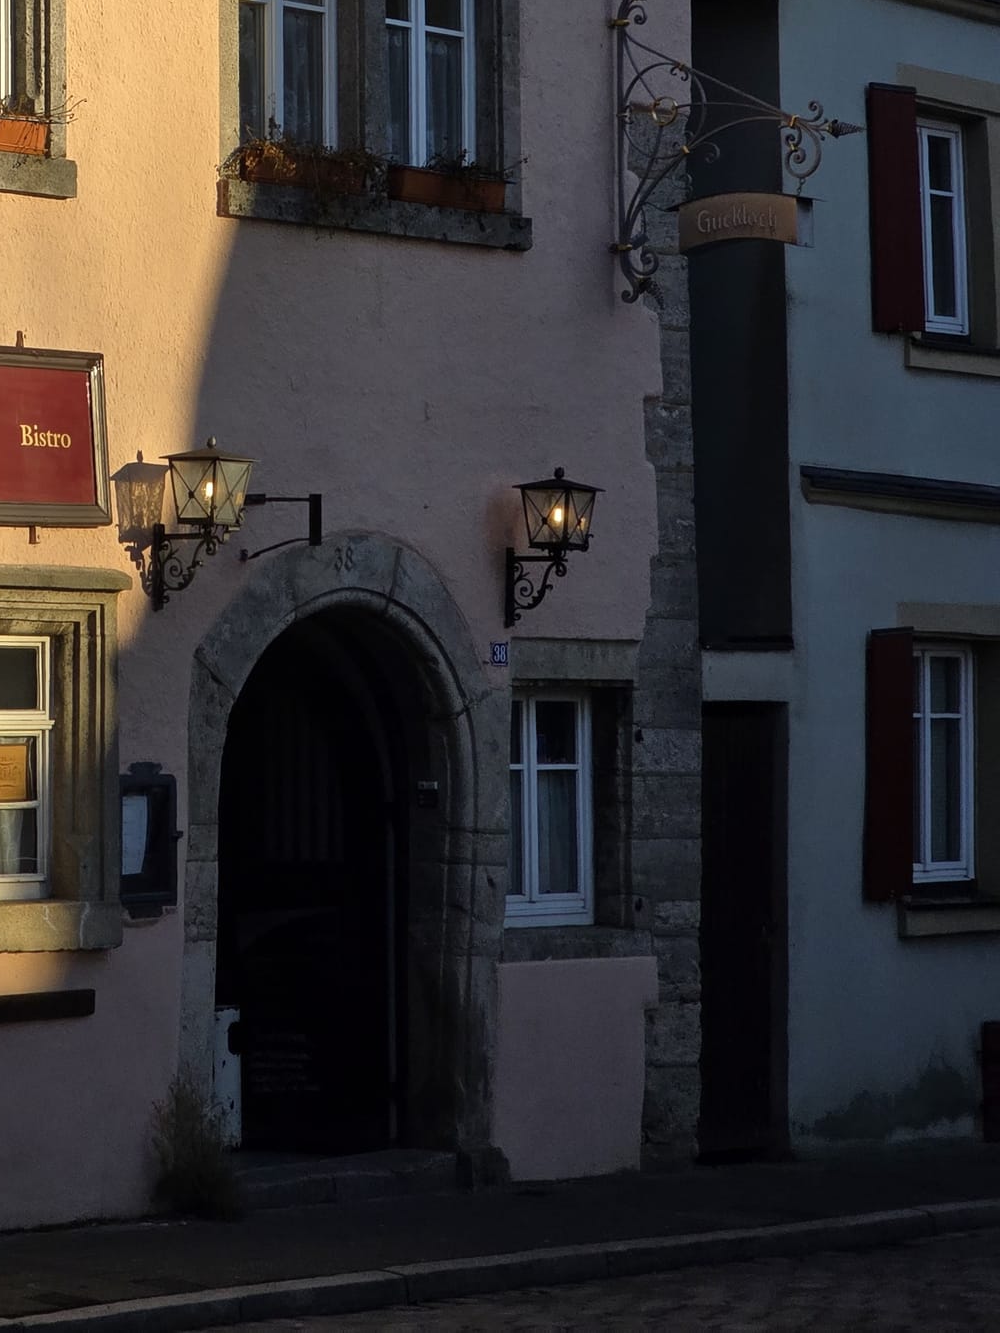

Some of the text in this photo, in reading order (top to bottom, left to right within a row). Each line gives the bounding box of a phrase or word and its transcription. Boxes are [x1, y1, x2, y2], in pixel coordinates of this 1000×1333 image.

[697, 202, 777, 235] Guckloch
[19, 424, 72, 449] Bistro
[494, 645, 506, 662] 38
